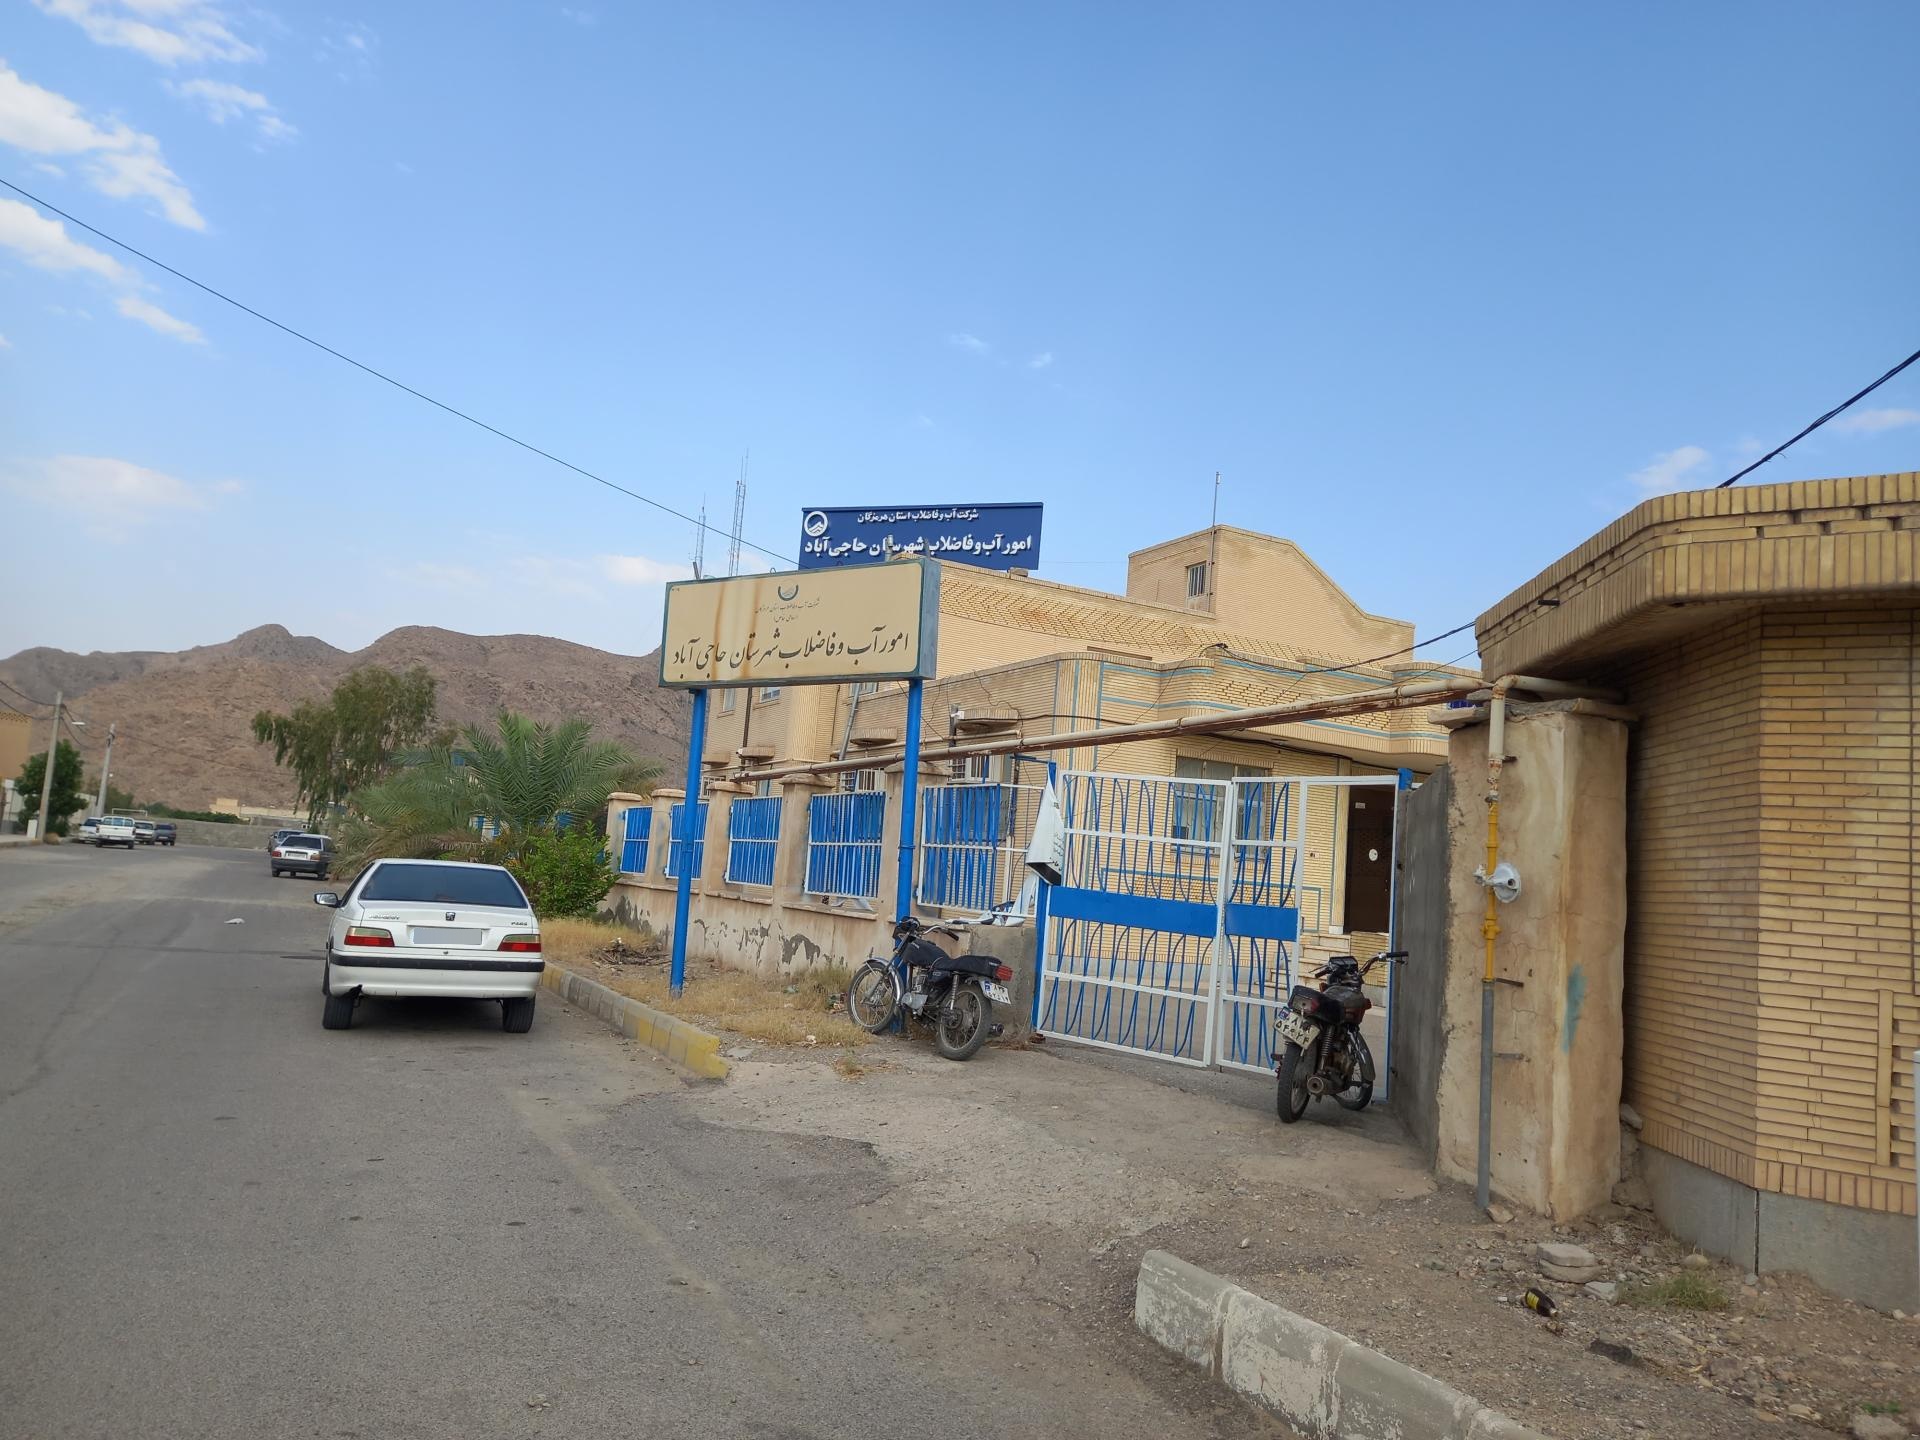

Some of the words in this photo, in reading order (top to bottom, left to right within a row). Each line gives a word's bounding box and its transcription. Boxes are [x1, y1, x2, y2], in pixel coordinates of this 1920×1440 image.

[857, 511, 888, 523] هرمزگان
[889, 511, 910, 522] استان
[944, 508, 957, 521] آب
[957, 508, 979, 520] شرکت
[982, 533, 1004, 556] آب
[1001, 534, 1032, 555] امور
[729, 627, 781, 669] شهرستان
[847, 625, 887, 666] آب
[879, 632, 909, 654] امور
